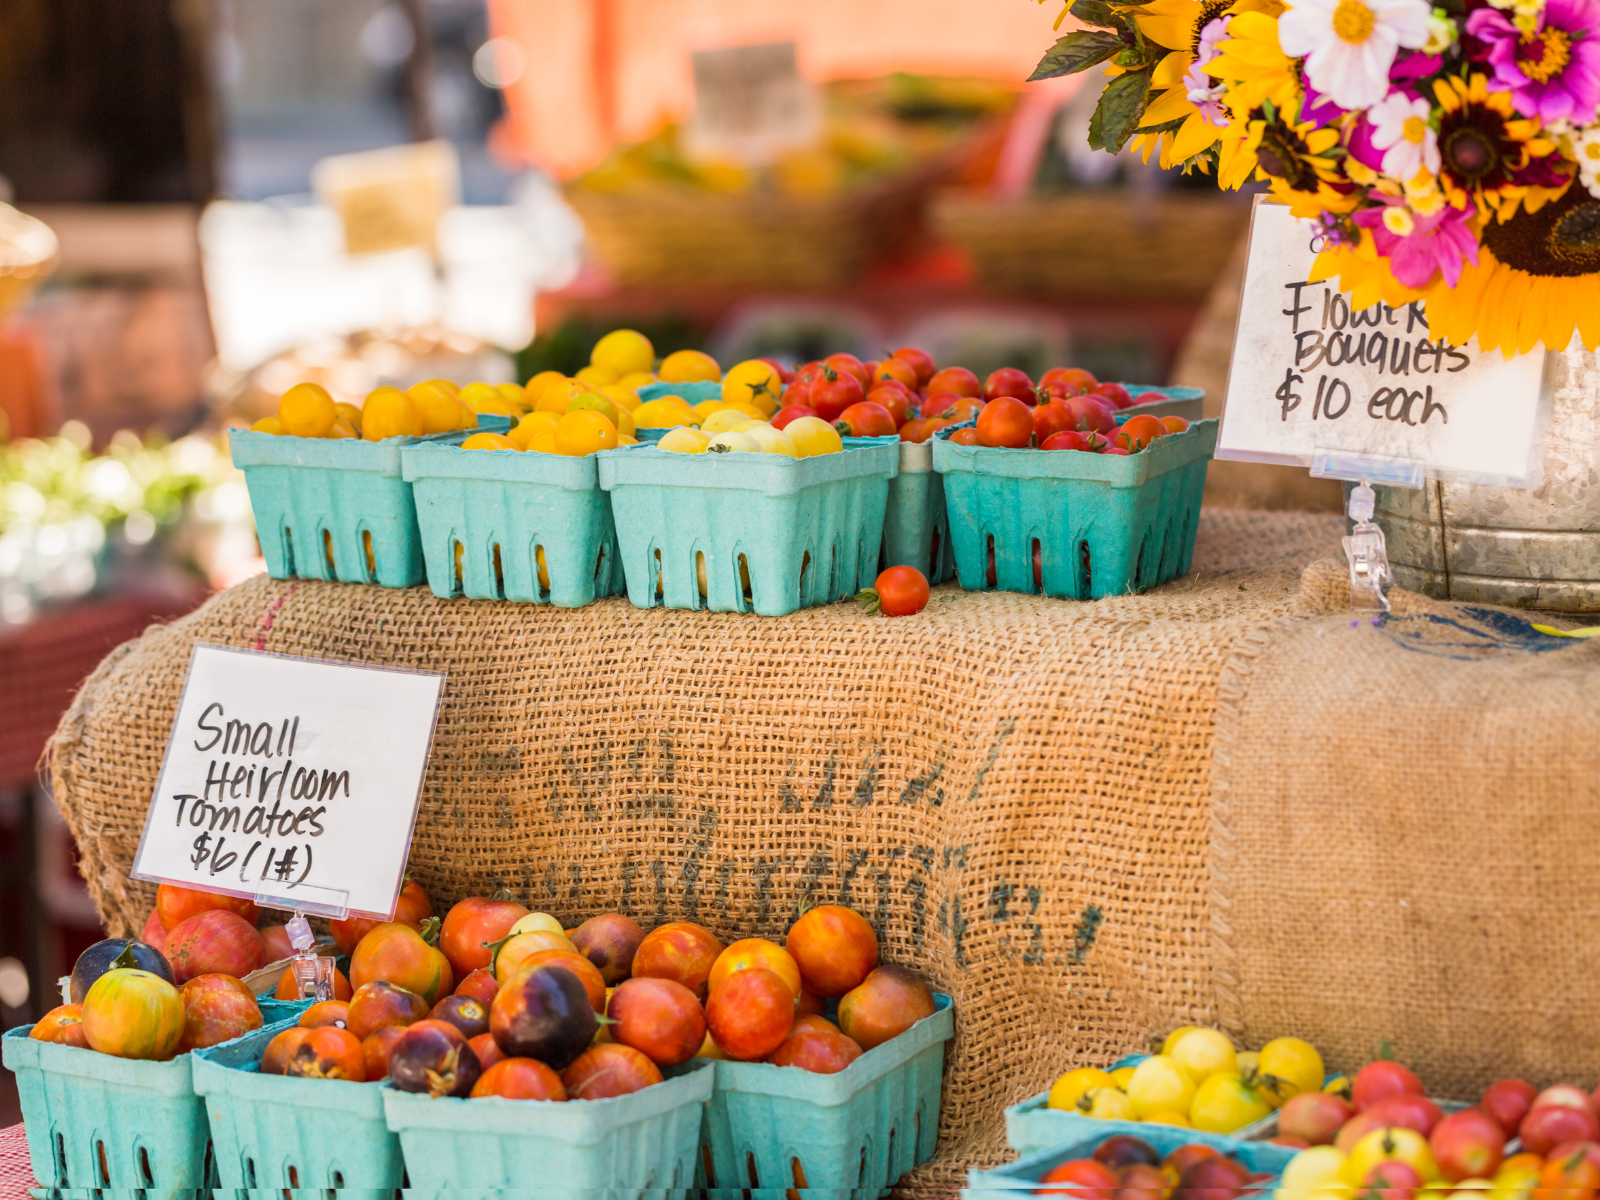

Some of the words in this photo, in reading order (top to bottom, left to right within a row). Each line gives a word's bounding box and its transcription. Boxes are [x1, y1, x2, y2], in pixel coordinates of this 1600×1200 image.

[1294, 330, 1471, 376] Bouquets
[1367, 385, 1448, 426] each
[194, 702, 300, 758] Small
[203, 760, 350, 803] Heirloom
[173, 794, 327, 838] Tomatoes
